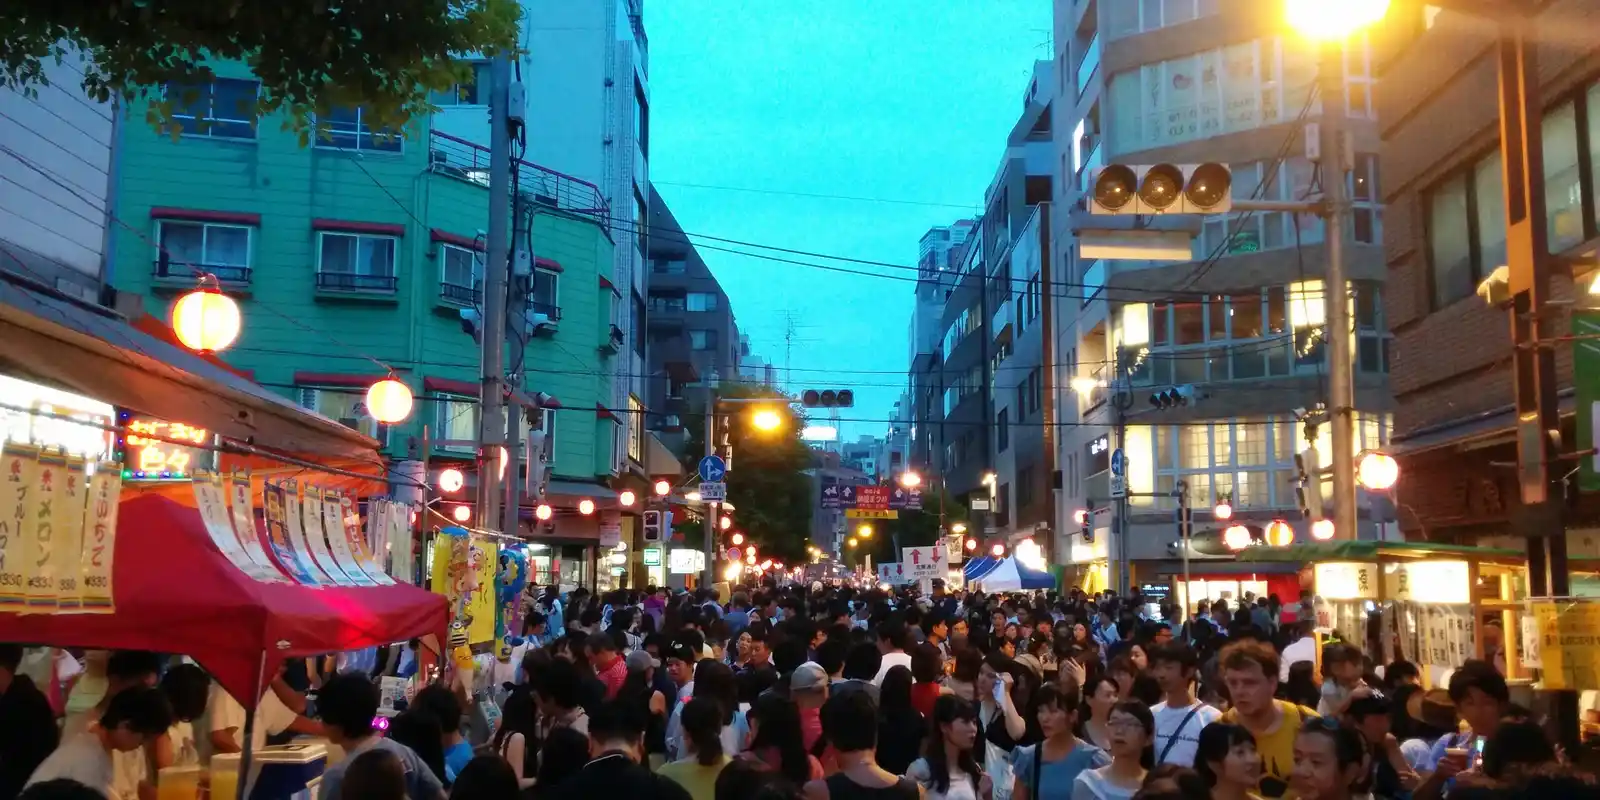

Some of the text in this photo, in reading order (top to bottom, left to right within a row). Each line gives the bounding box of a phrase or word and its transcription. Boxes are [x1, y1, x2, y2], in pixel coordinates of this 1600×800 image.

[14, 486, 29, 538] ブルー
[37, 500, 52, 567] メロン
